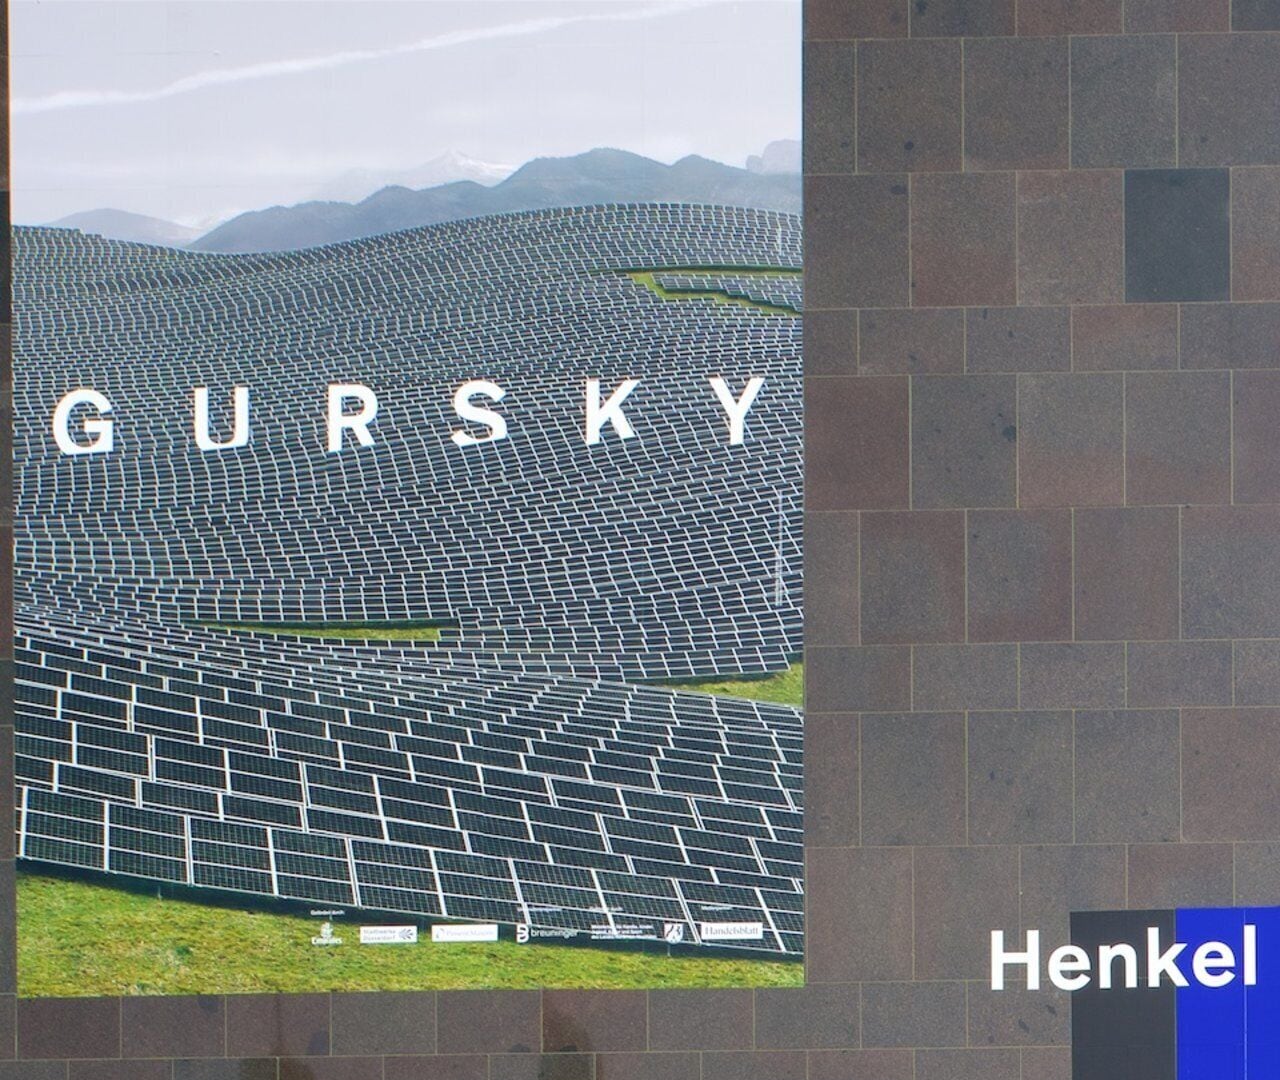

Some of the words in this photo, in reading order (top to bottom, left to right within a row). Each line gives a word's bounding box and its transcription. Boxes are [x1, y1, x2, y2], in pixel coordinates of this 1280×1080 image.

[52, 377, 766, 455] GURSKY
[705, 926, 759, 936] Handelsblatt
[989, 924, 1257, 991] Henkel
